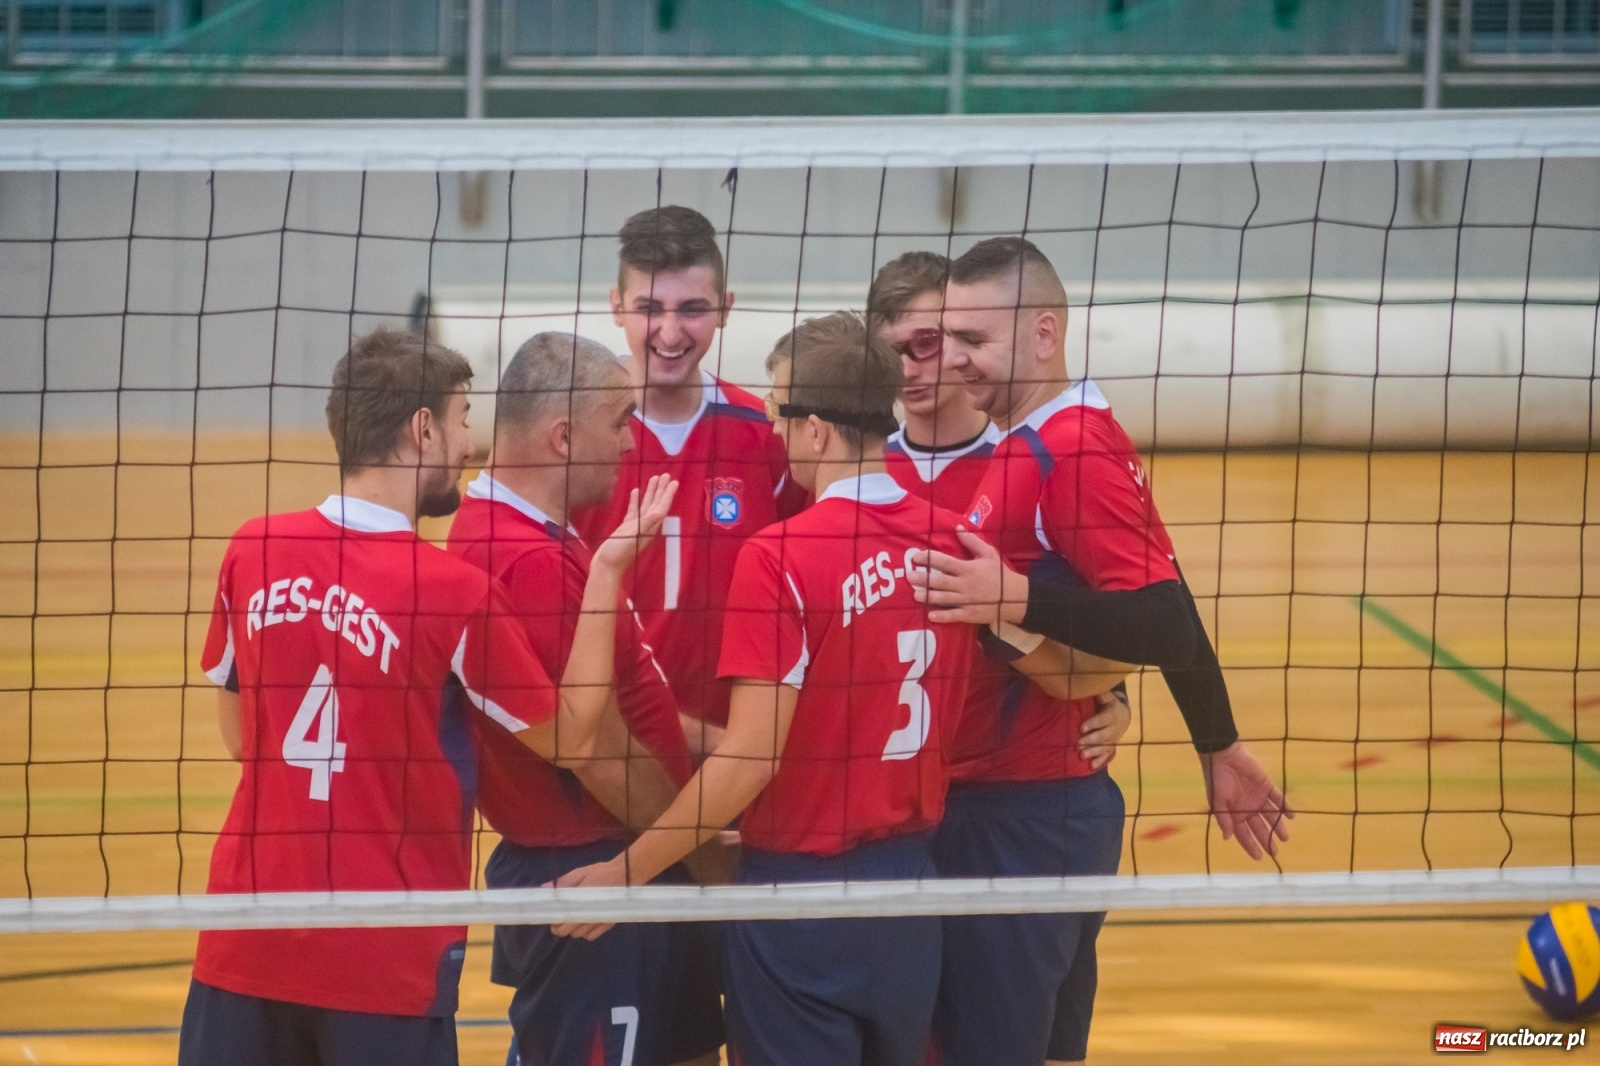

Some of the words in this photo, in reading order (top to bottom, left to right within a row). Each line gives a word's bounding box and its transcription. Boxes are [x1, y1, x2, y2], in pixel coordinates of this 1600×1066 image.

[661, 516, 681, 610] 1
[842, 547, 938, 628] RES-G
[247, 576, 400, 674] RES-GEST
[282, 664, 346, 801] 4
[881, 629, 937, 761] 3
[611, 1006, 639, 1066] 7
